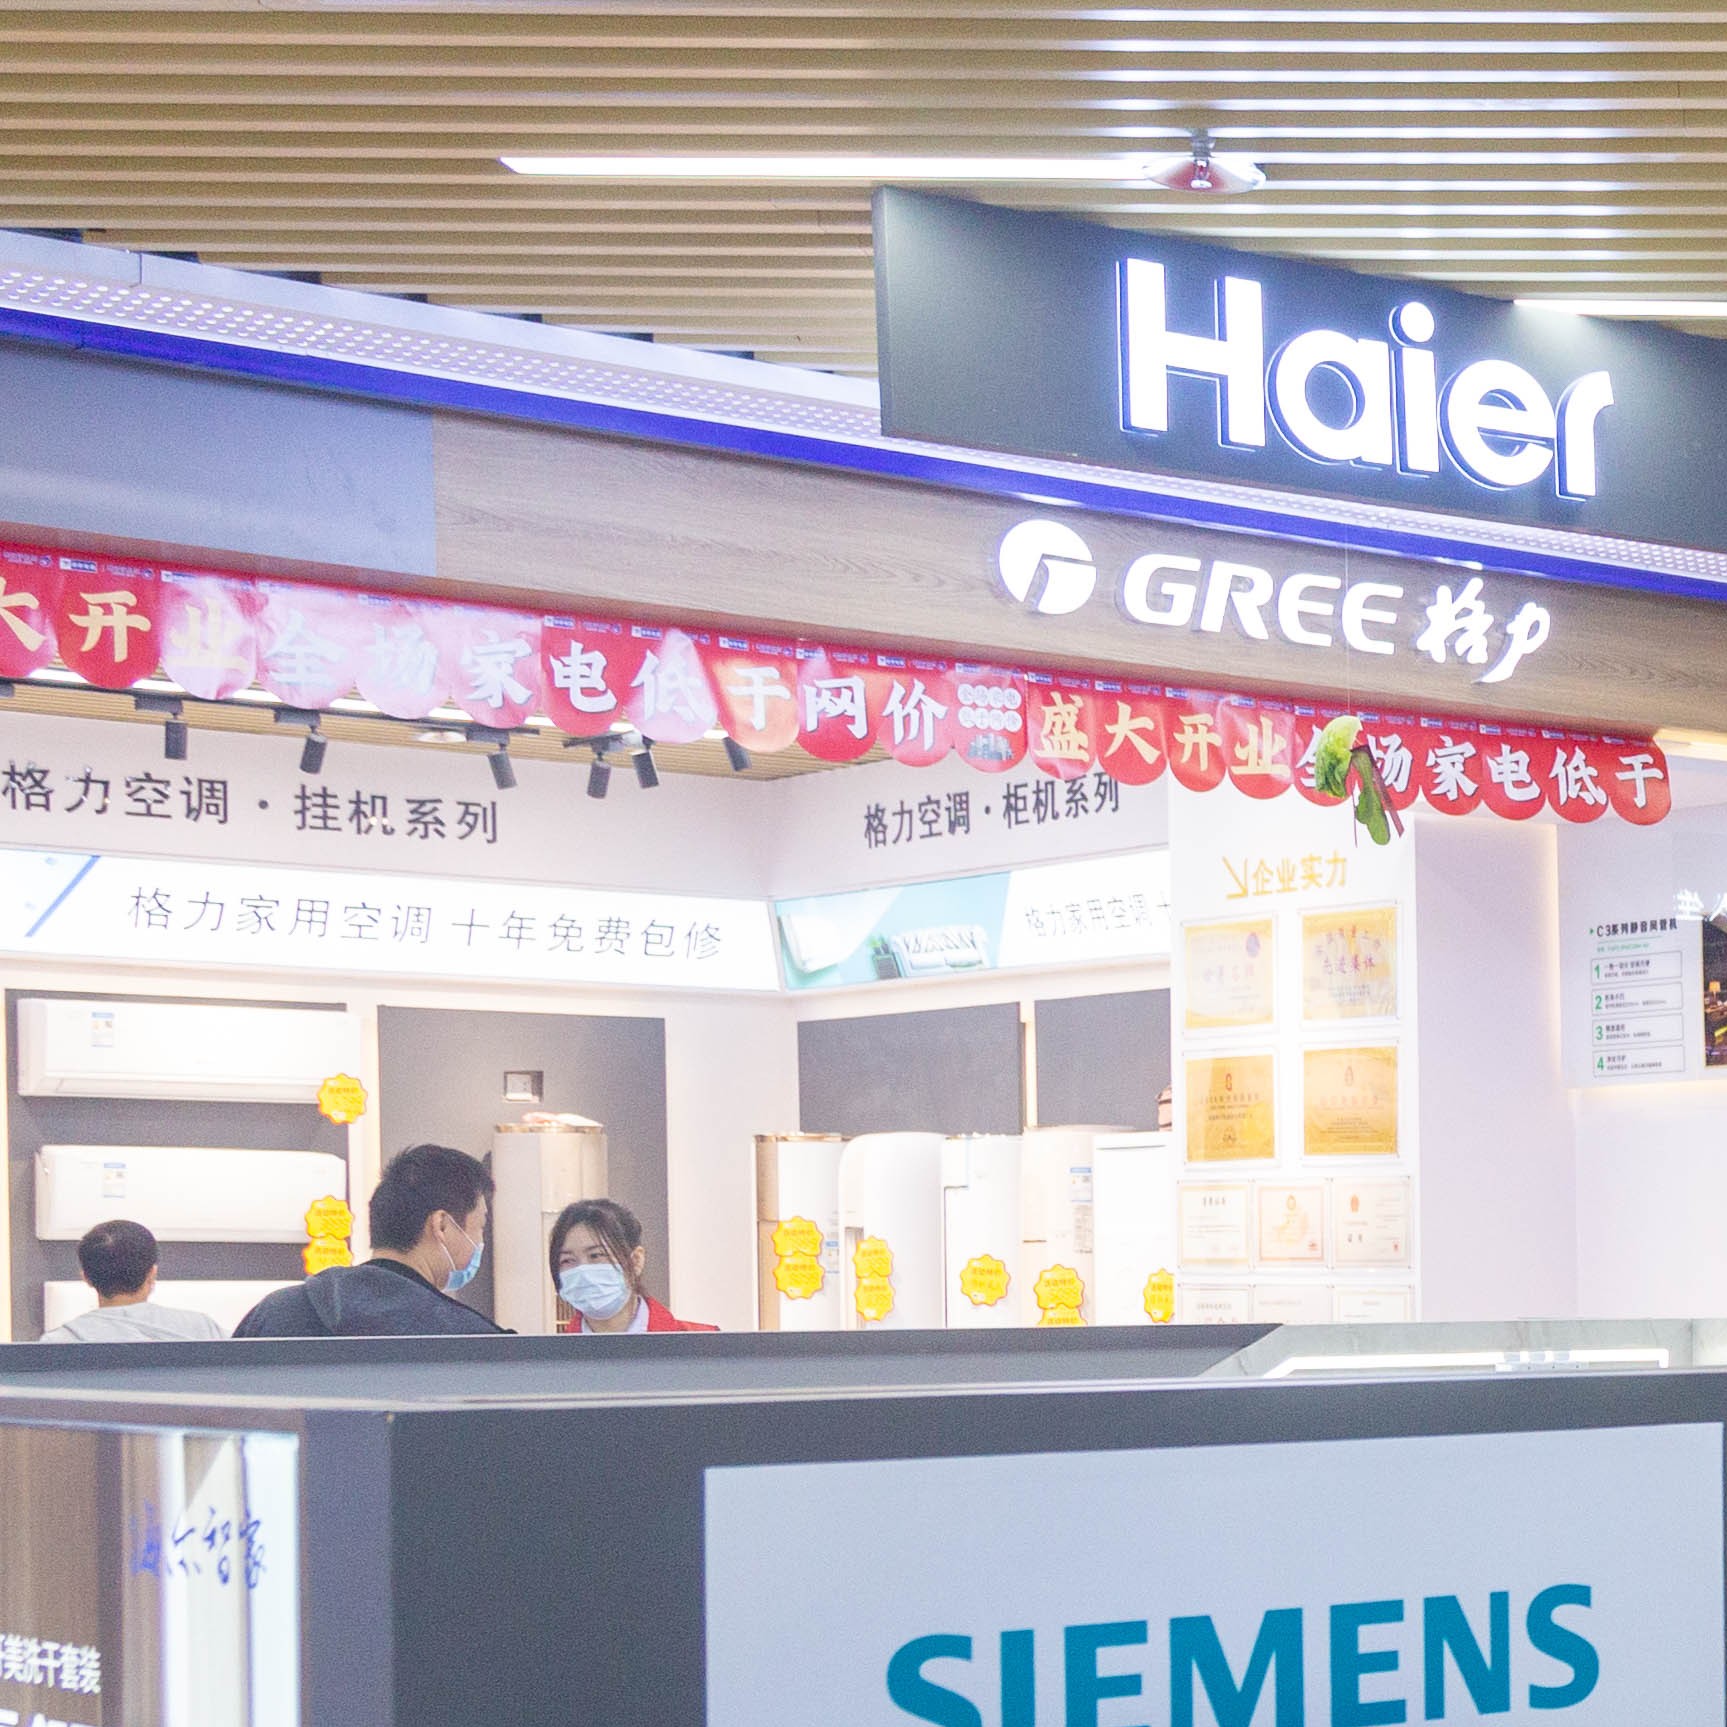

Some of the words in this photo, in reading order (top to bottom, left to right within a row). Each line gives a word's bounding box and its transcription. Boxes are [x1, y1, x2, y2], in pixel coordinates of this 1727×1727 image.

[1116, 258, 1615, 501] Haier
[1124, 554, 1404, 656] GREE
[1417, 577, 1552, 684] 格力
[1252, 850, 1348, 897] 企业实力
[128, 887, 432, 945] 格力家用空调
[452, 910, 724, 961] 十年免费包修
[1594, 995, 1603, 1011] 2
[1595, 1025, 1604, 1041] 3
[1596, 1056, 1605, 1072] 4
